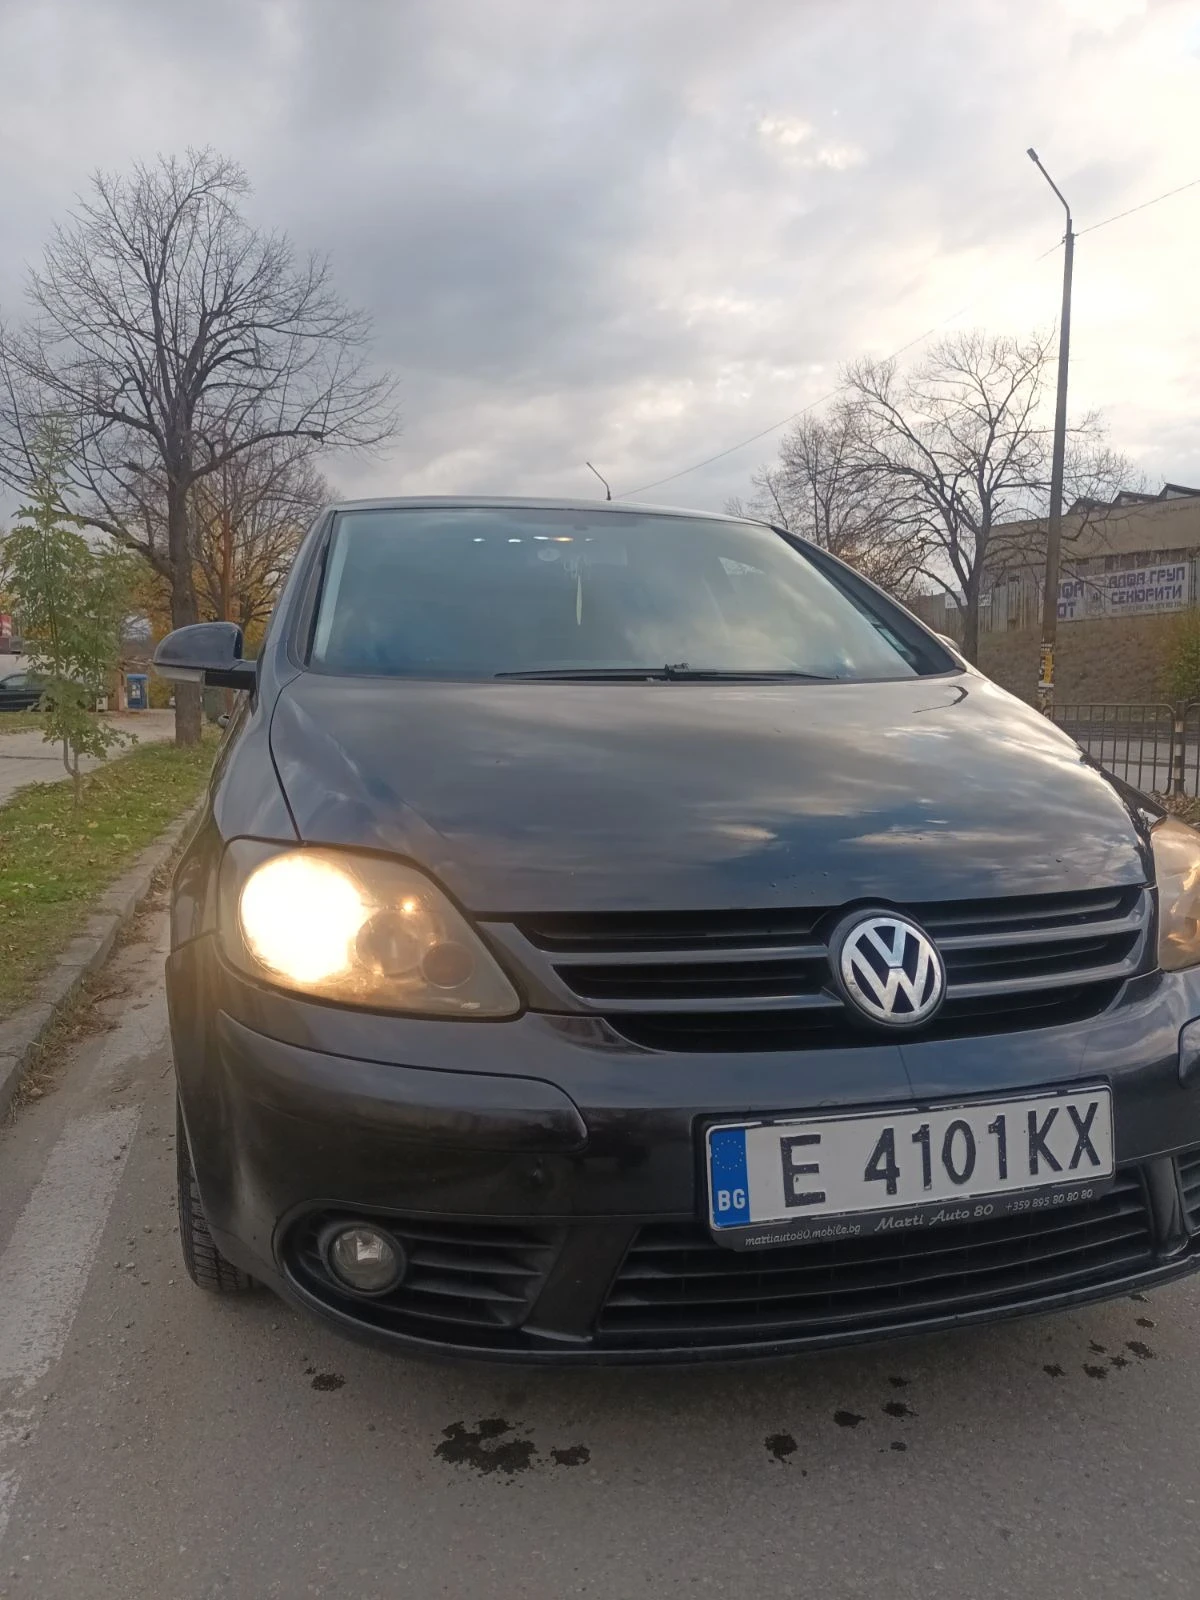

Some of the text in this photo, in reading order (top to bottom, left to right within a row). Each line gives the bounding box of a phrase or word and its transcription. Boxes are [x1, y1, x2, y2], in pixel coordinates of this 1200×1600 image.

[1149, 566, 1186, 585] ГРУП
[1057, 581, 1085, 600] ФА
[1111, 585, 1183, 605] СЕКЮРИТИ
[1057, 601, 1077, 618] ОТ
[841, 917, 942, 1024] VW
[779, 1133, 826, 1208] E
[717, 1188, 746, 1211] BG
[873, 1202, 995, 1233] Marti Auto 80
